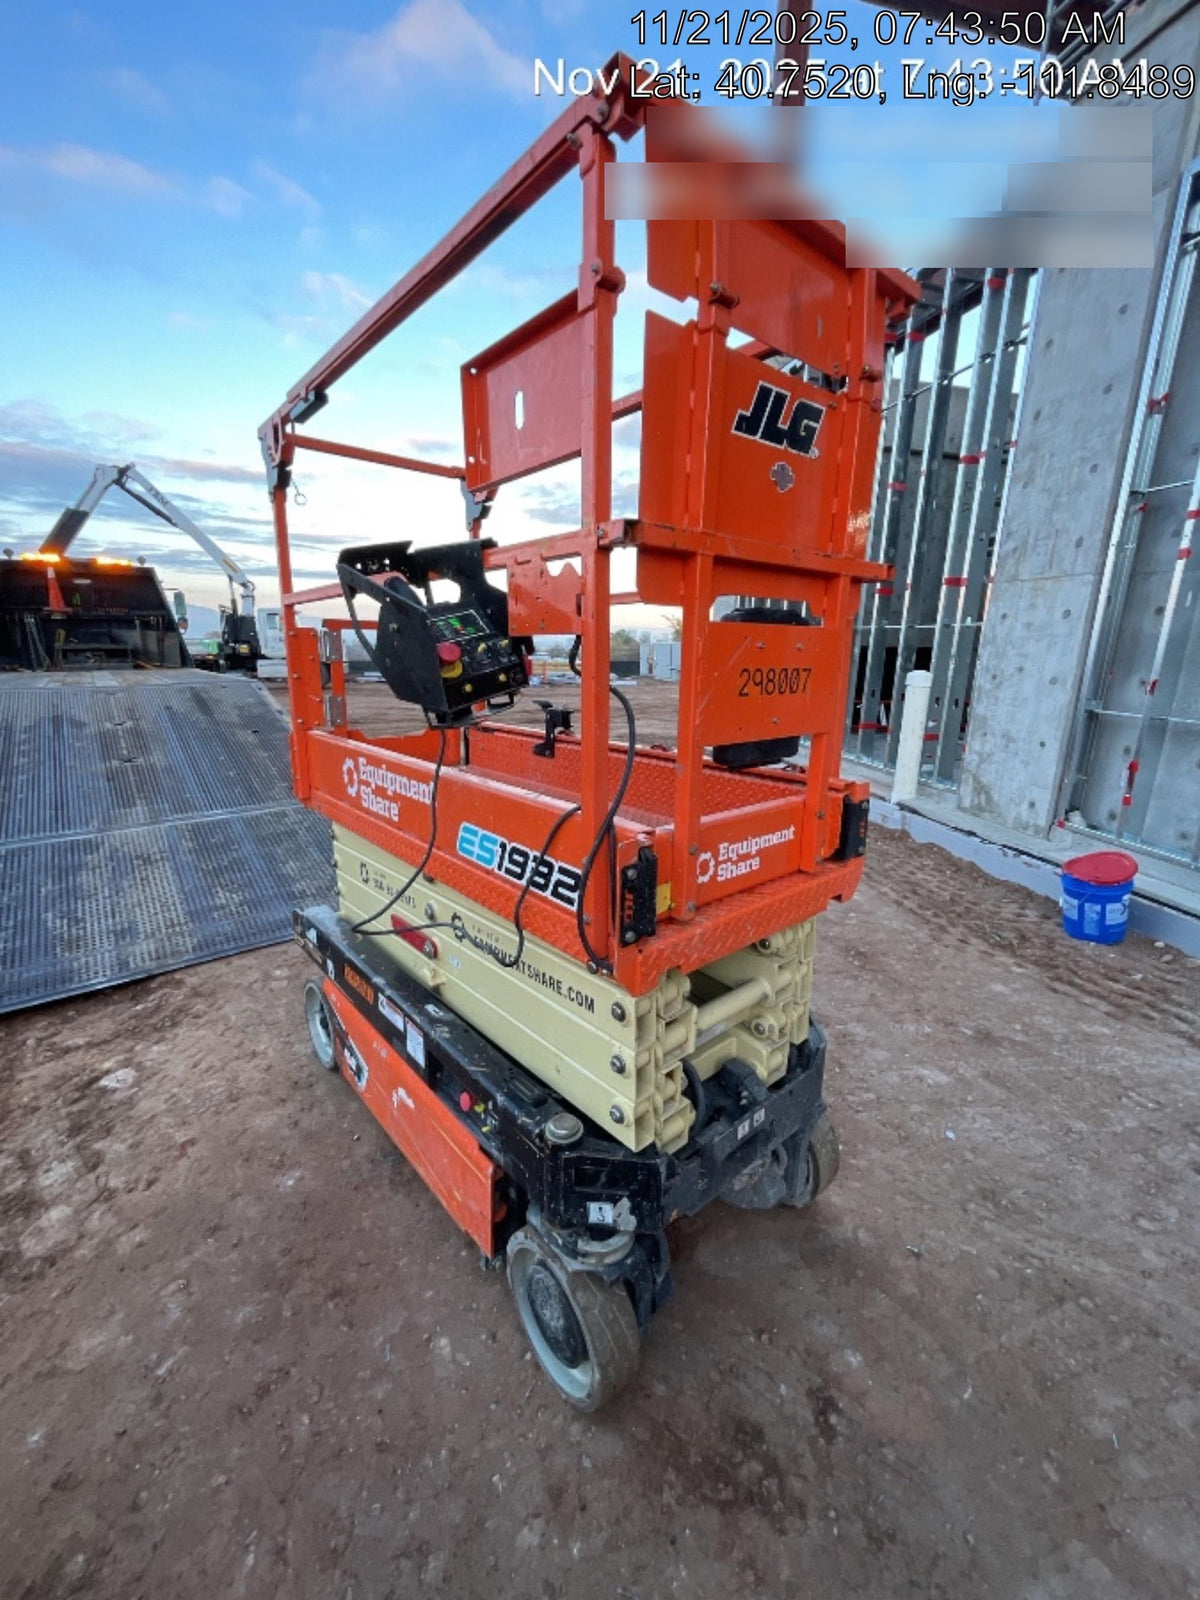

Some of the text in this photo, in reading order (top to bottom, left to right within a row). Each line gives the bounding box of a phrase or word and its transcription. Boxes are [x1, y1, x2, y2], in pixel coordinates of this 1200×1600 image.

[731, 380, 825, 456] JLG
[739, 668, 812, 697] 298007
[358, 756, 434, 805] Equipment
[360, 785, 399, 822] Share
[718, 825, 795, 861] Equipment
[717, 857, 760, 882] Share
